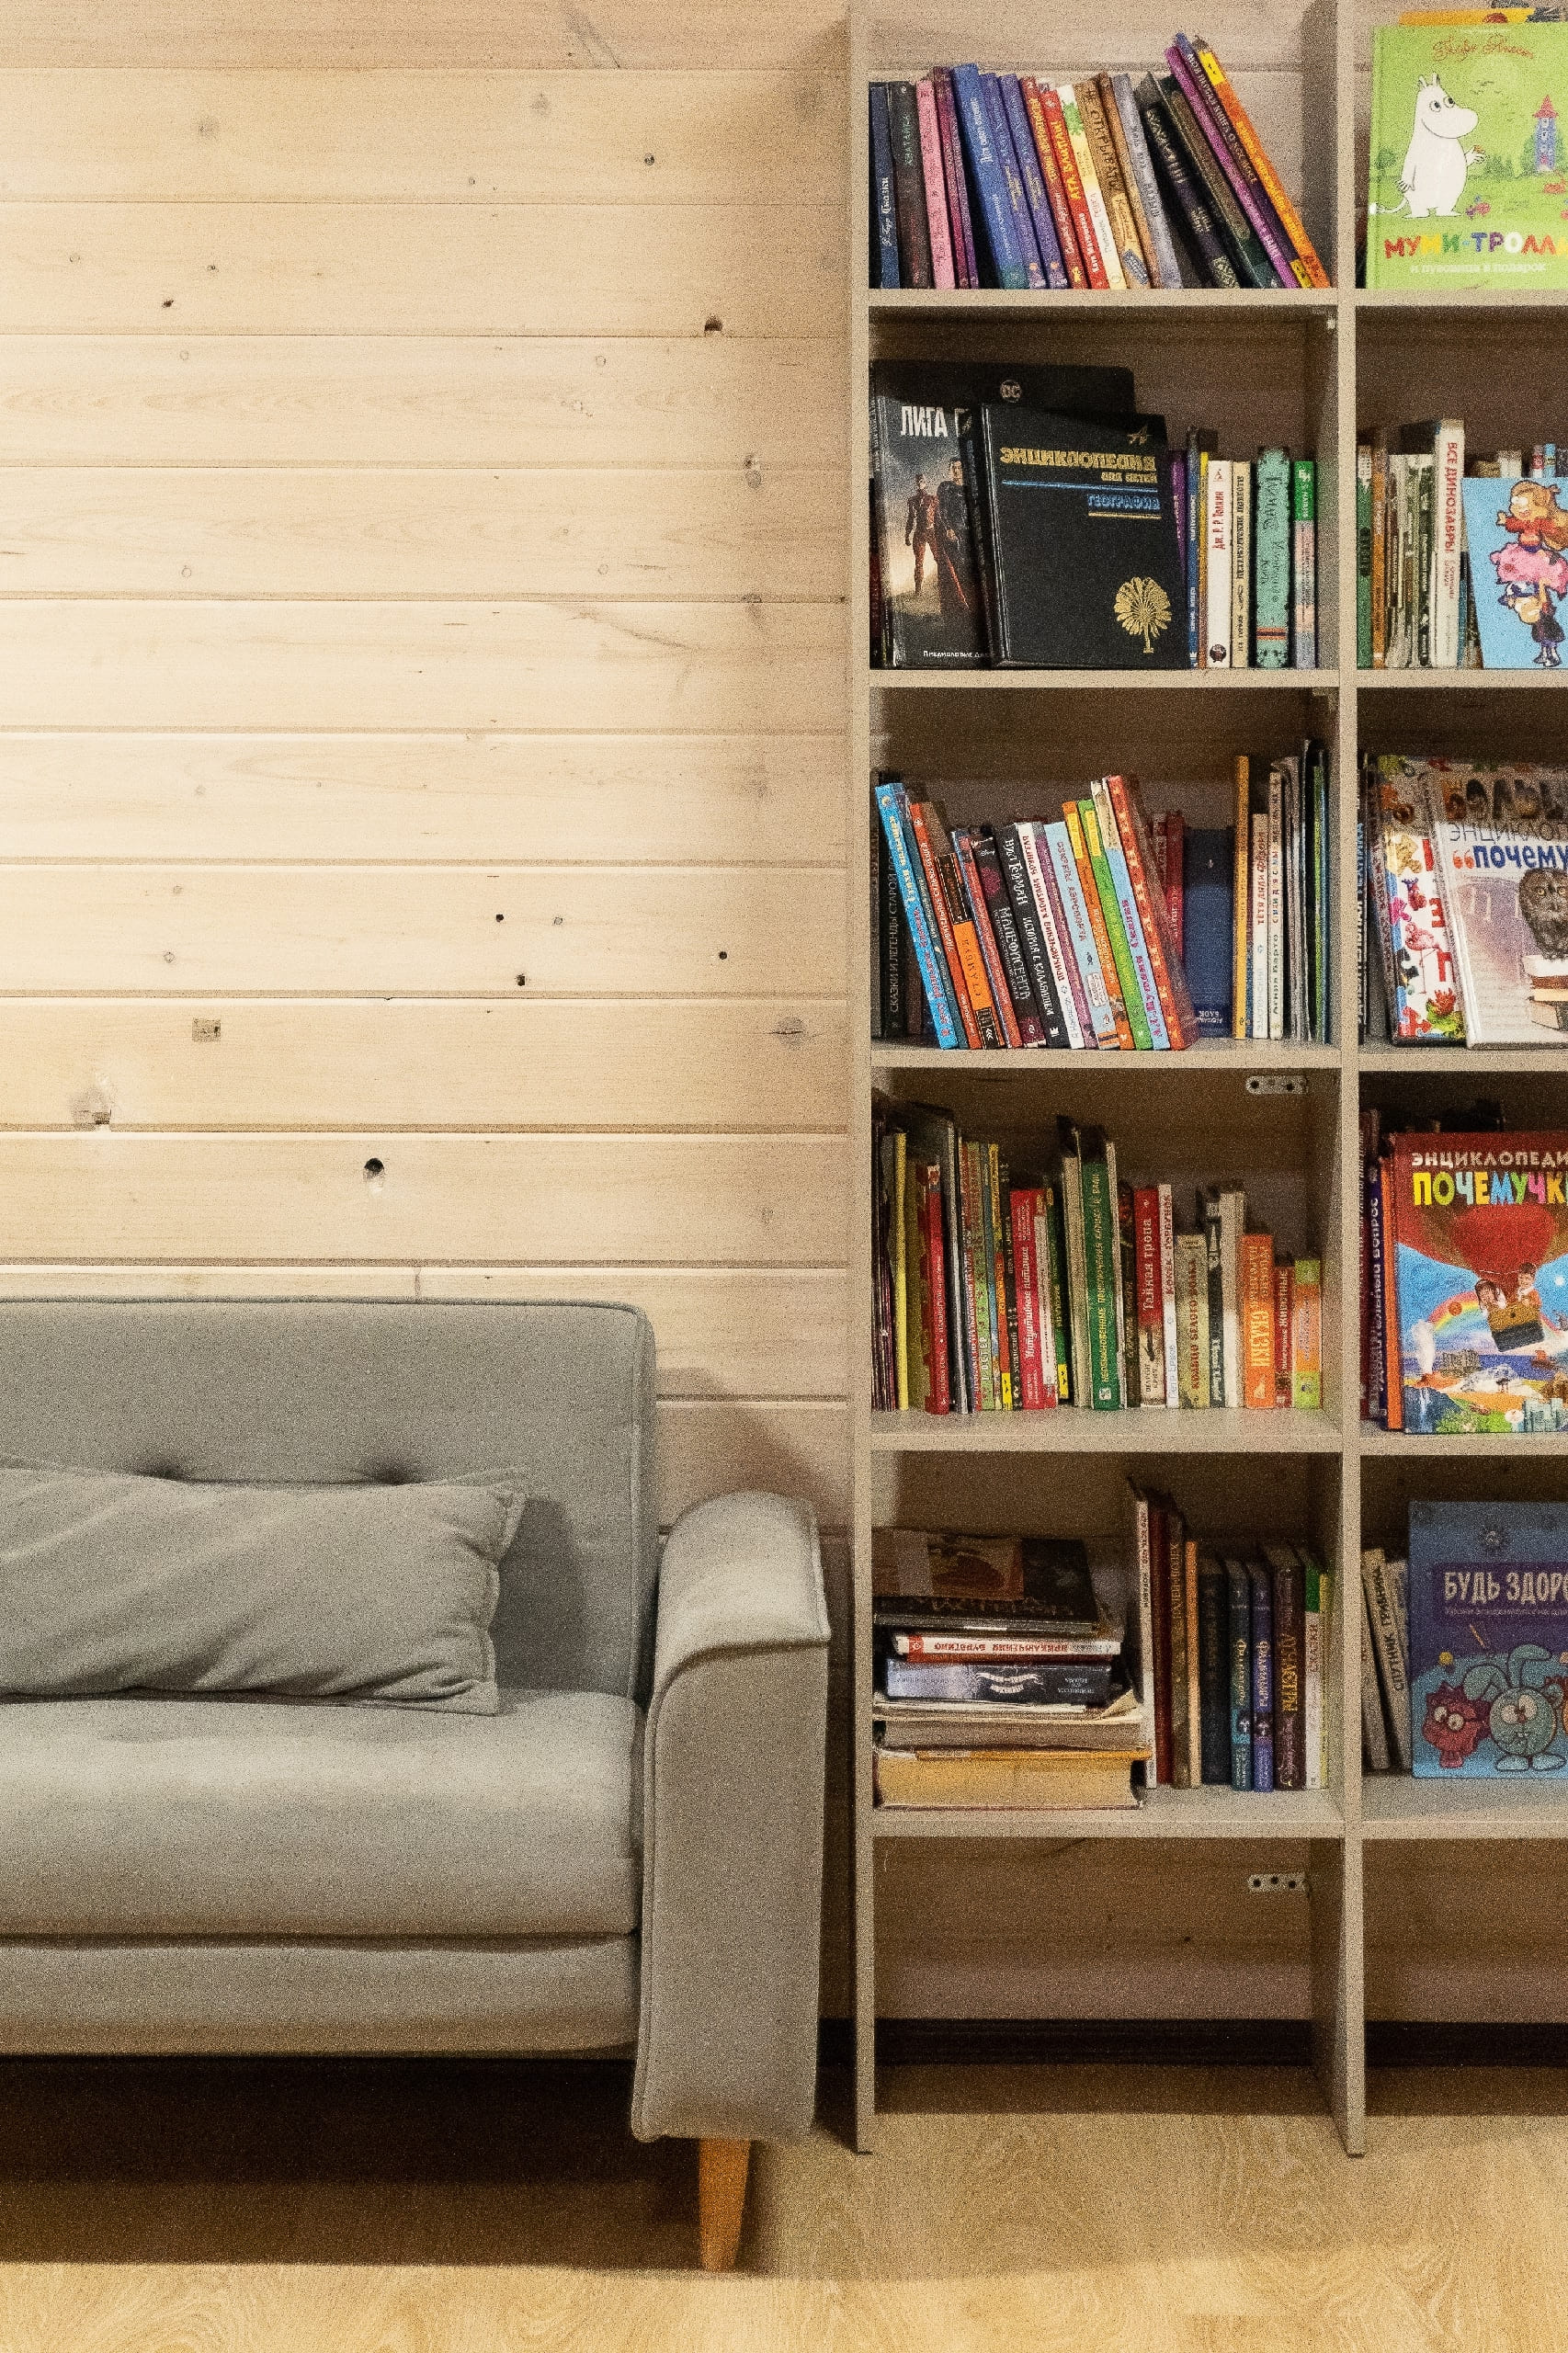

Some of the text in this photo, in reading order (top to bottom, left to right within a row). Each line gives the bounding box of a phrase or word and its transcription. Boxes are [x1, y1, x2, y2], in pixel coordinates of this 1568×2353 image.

[878, 176, 891, 214] Сказки
[1494, 263, 1545, 272] подарок
[901, 406, 948, 437] ЛИГА
[999, 446, 1156, 473] ЭНЦИКЛОПЕДИЯ
[1086, 492, 1161, 511] ГЕОГРАФИЯ
[1212, 491, 1224, 517] Толкин
[1443, 441, 1458, 553] ВСЕ ДИНОЗАВРЫ
[1211, 534, 1225, 550] Дж.
[1021, 834, 1039, 876] ВРУНГЕЛЯ
[1032, 876, 1050, 919] КАПИТАНА
[886, 872, 899, 1013] СКАЗКИ И ЛЕГЕНДЫ СТАРОЙ
[1119, 896, 1141, 949] Сказки
[960, 938, 983, 995] СТАМБУЛ
[998, 905, 1032, 999] МАЛЕФИСЕНТА
[1021, 915, 1040, 953] ИСТОРИЯ
[1032, 961, 1055, 1017] КЛАДБИЩЕМ
[1043, 919, 1065, 983] ПРИКЛЮЧЕНИЯ
[1411, 1151, 1568, 1169] ЭНЦИКЛОПЕДИ
[1413, 1169, 1568, 1207] ПОЧЕМУЧК
[1019, 1245, 1031, 1290] питание
[1094, 1241, 1106, 1303] ПРИКЛЮЧЕНИЯ
[1141, 1217, 1154, 1311] Тайная тропа
[1278, 1267, 1289, 1326] ЖИВОТНЫЕ
[1020, 1290, 1038, 1358] Интуитивное
[1096, 1306, 1109, 1382] НЕОБЫКНОВЕННЫЕ
[1187, 1259, 1200, 1389] КОЛЬЦО БЕЛОГО ВОЛКА
[1249, 1310, 1269, 1368] СКАЗКИ
[979, 1336, 989, 1370] ОСТЕР
[1141, 1572, 1149, 1608] КОРАБЛИ
[1444, 1571, 1500, 1604] БУДЬ
[933, 1641, 1067, 1653] ПРИКЛЮЧЕНИЯ БУРАТИНО
[1309, 1623, 1318, 1672] СКАЗКИ
[1370, 1564, 1404, 1692] СПУТНИК ГРИБНИКА
